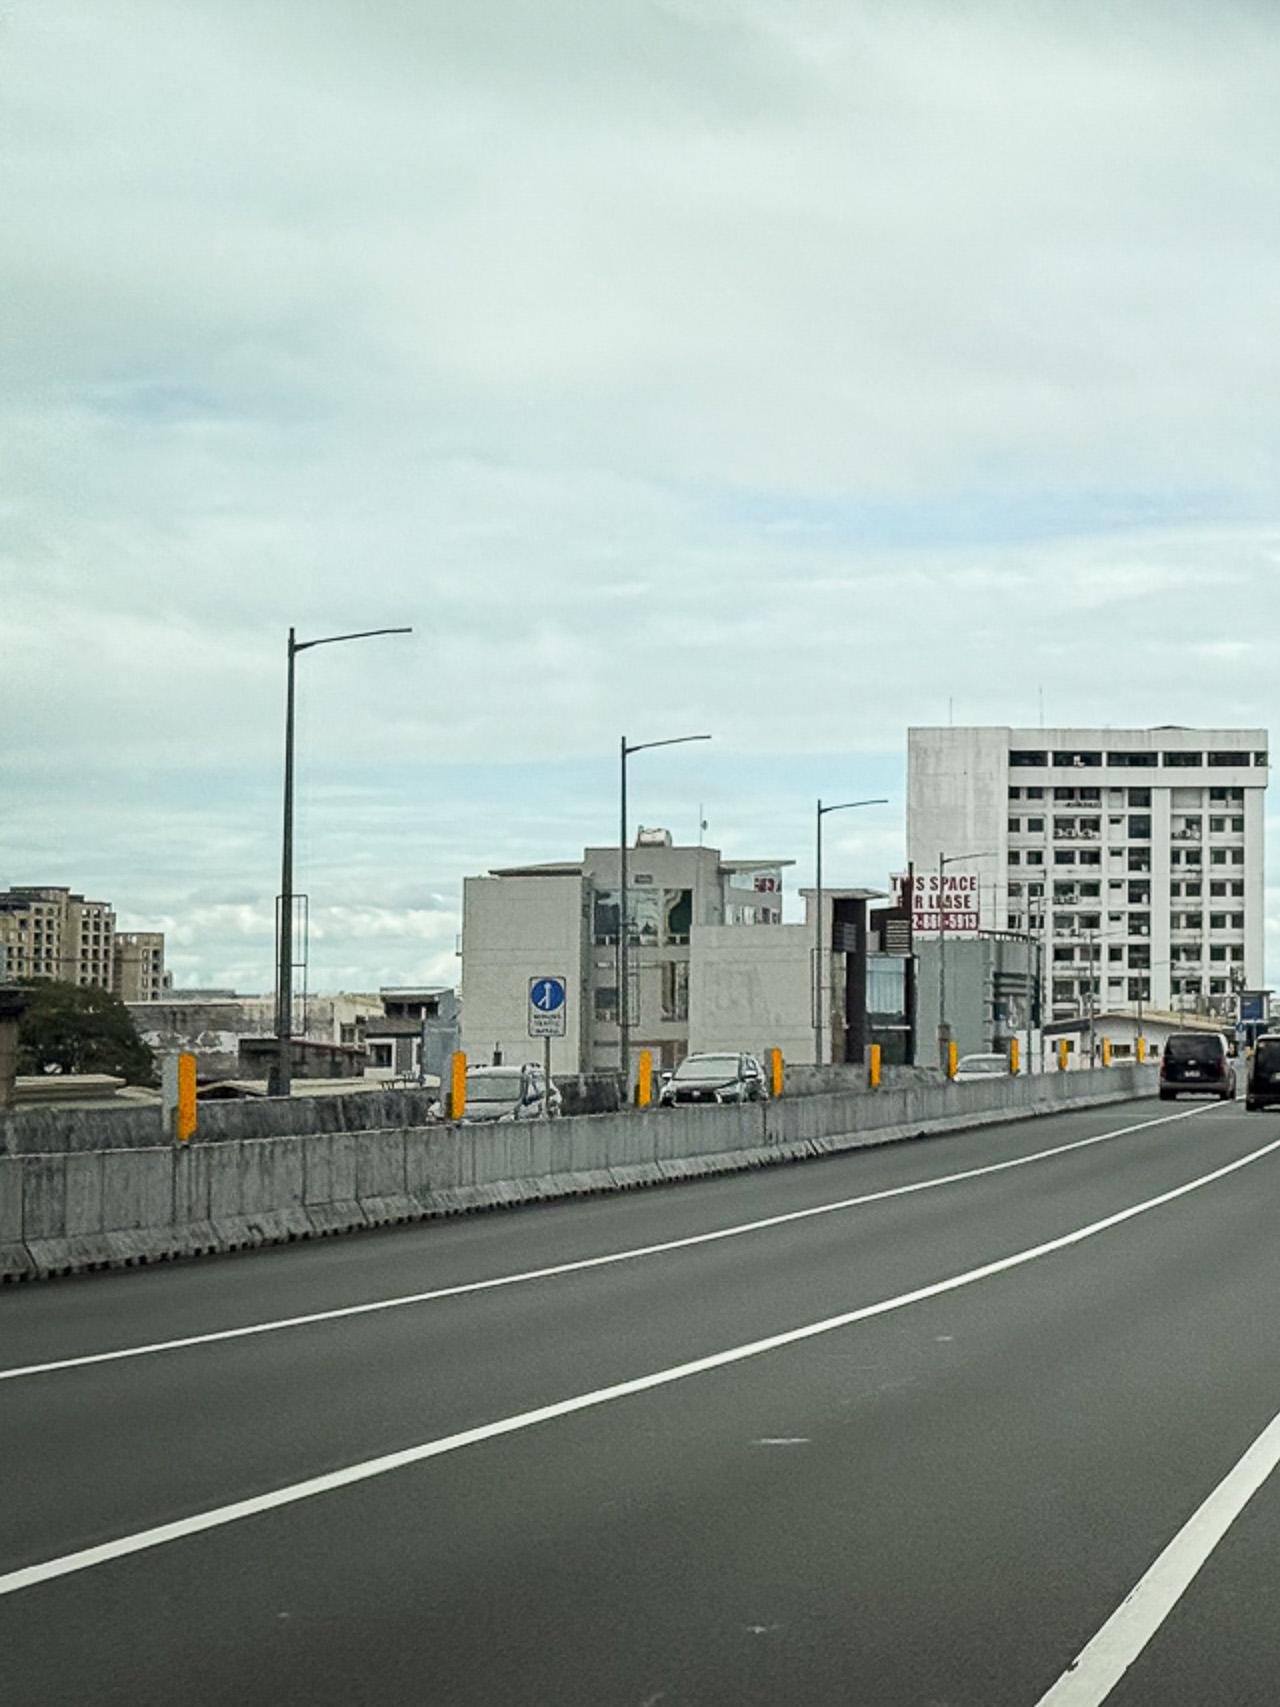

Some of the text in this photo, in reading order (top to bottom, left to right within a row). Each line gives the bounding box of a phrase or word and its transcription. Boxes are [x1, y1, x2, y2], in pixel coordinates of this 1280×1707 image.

[890, 876, 977, 892] TS SPACE
[896, 894, 923, 909] FR
